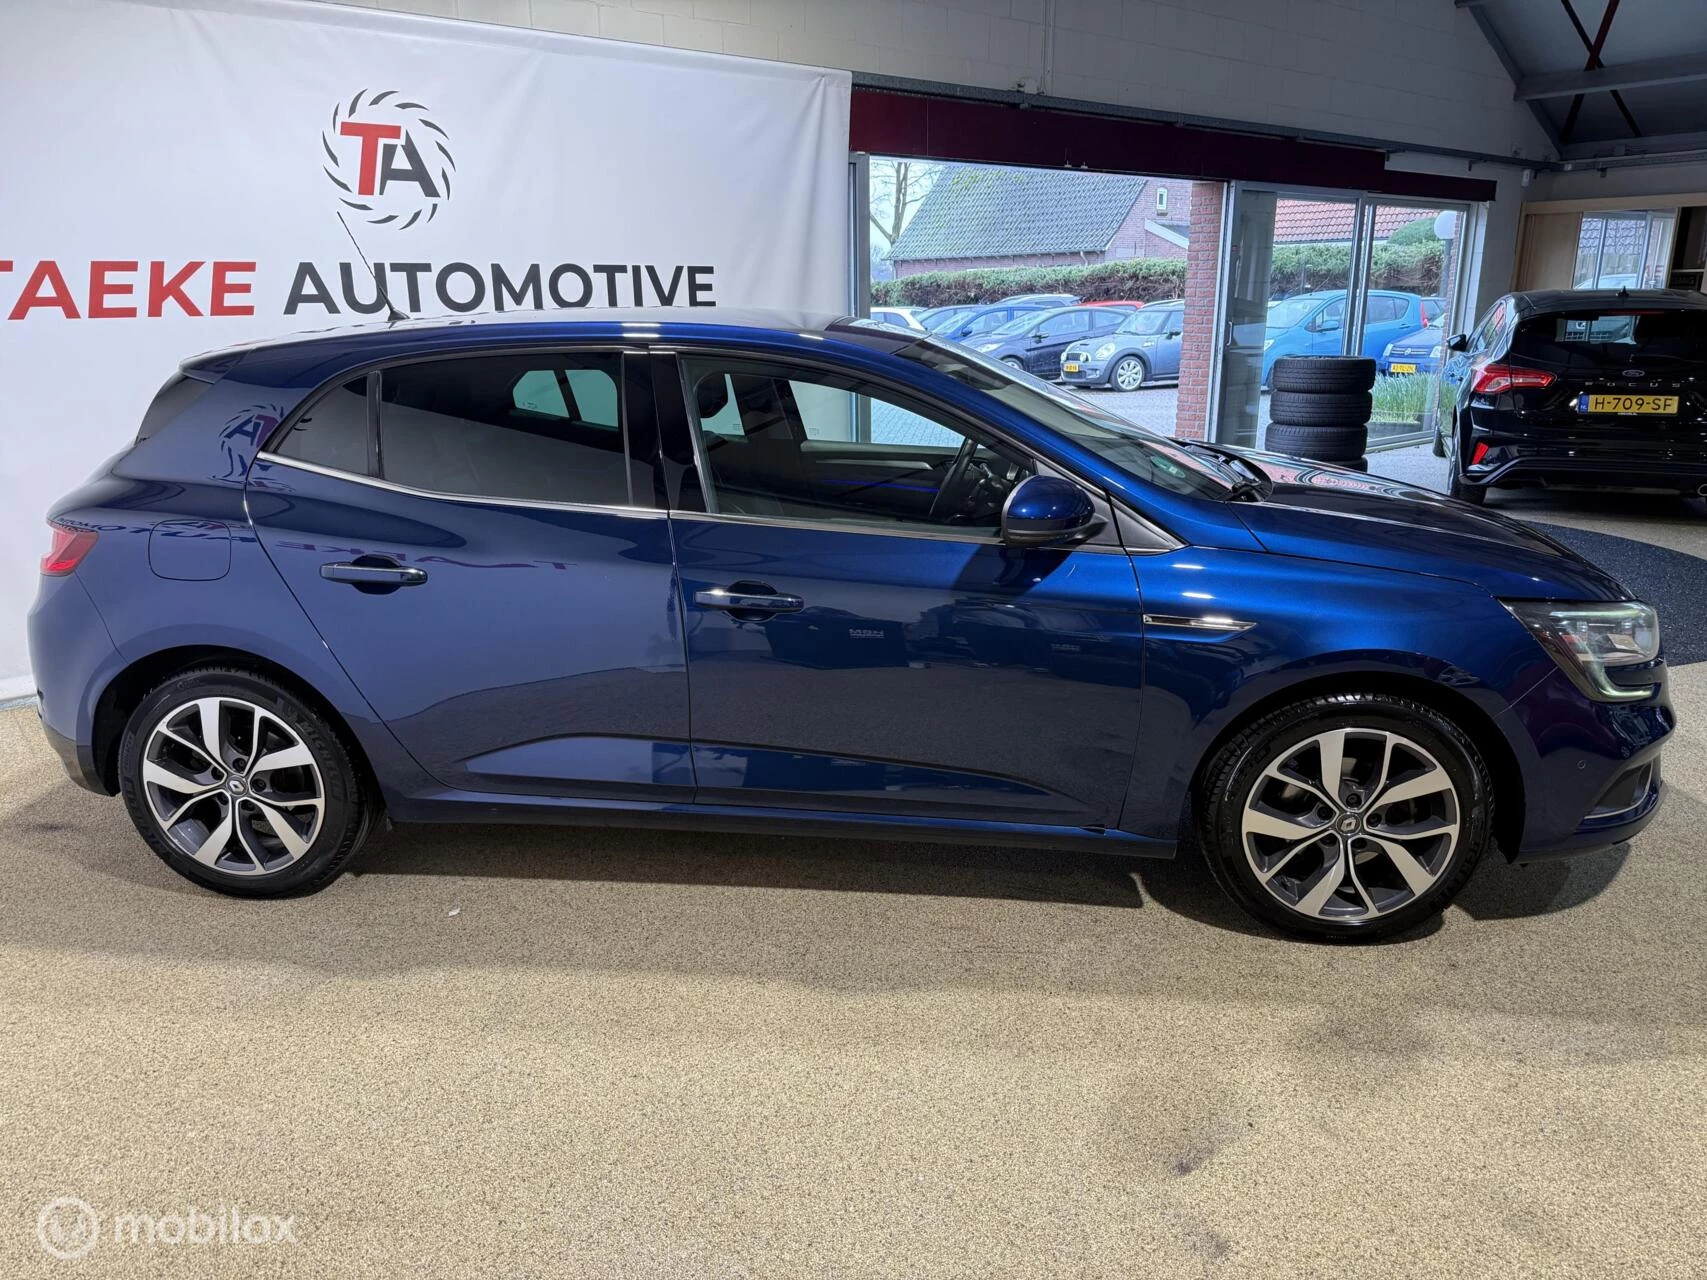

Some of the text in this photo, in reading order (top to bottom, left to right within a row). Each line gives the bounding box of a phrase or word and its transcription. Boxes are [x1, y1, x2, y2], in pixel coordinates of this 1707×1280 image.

[340, 121, 441, 198] TA
[0, 260, 717, 320] AEKE AUTOMOTIVE
[1594, 397, 1673, 411] H-709-SF
